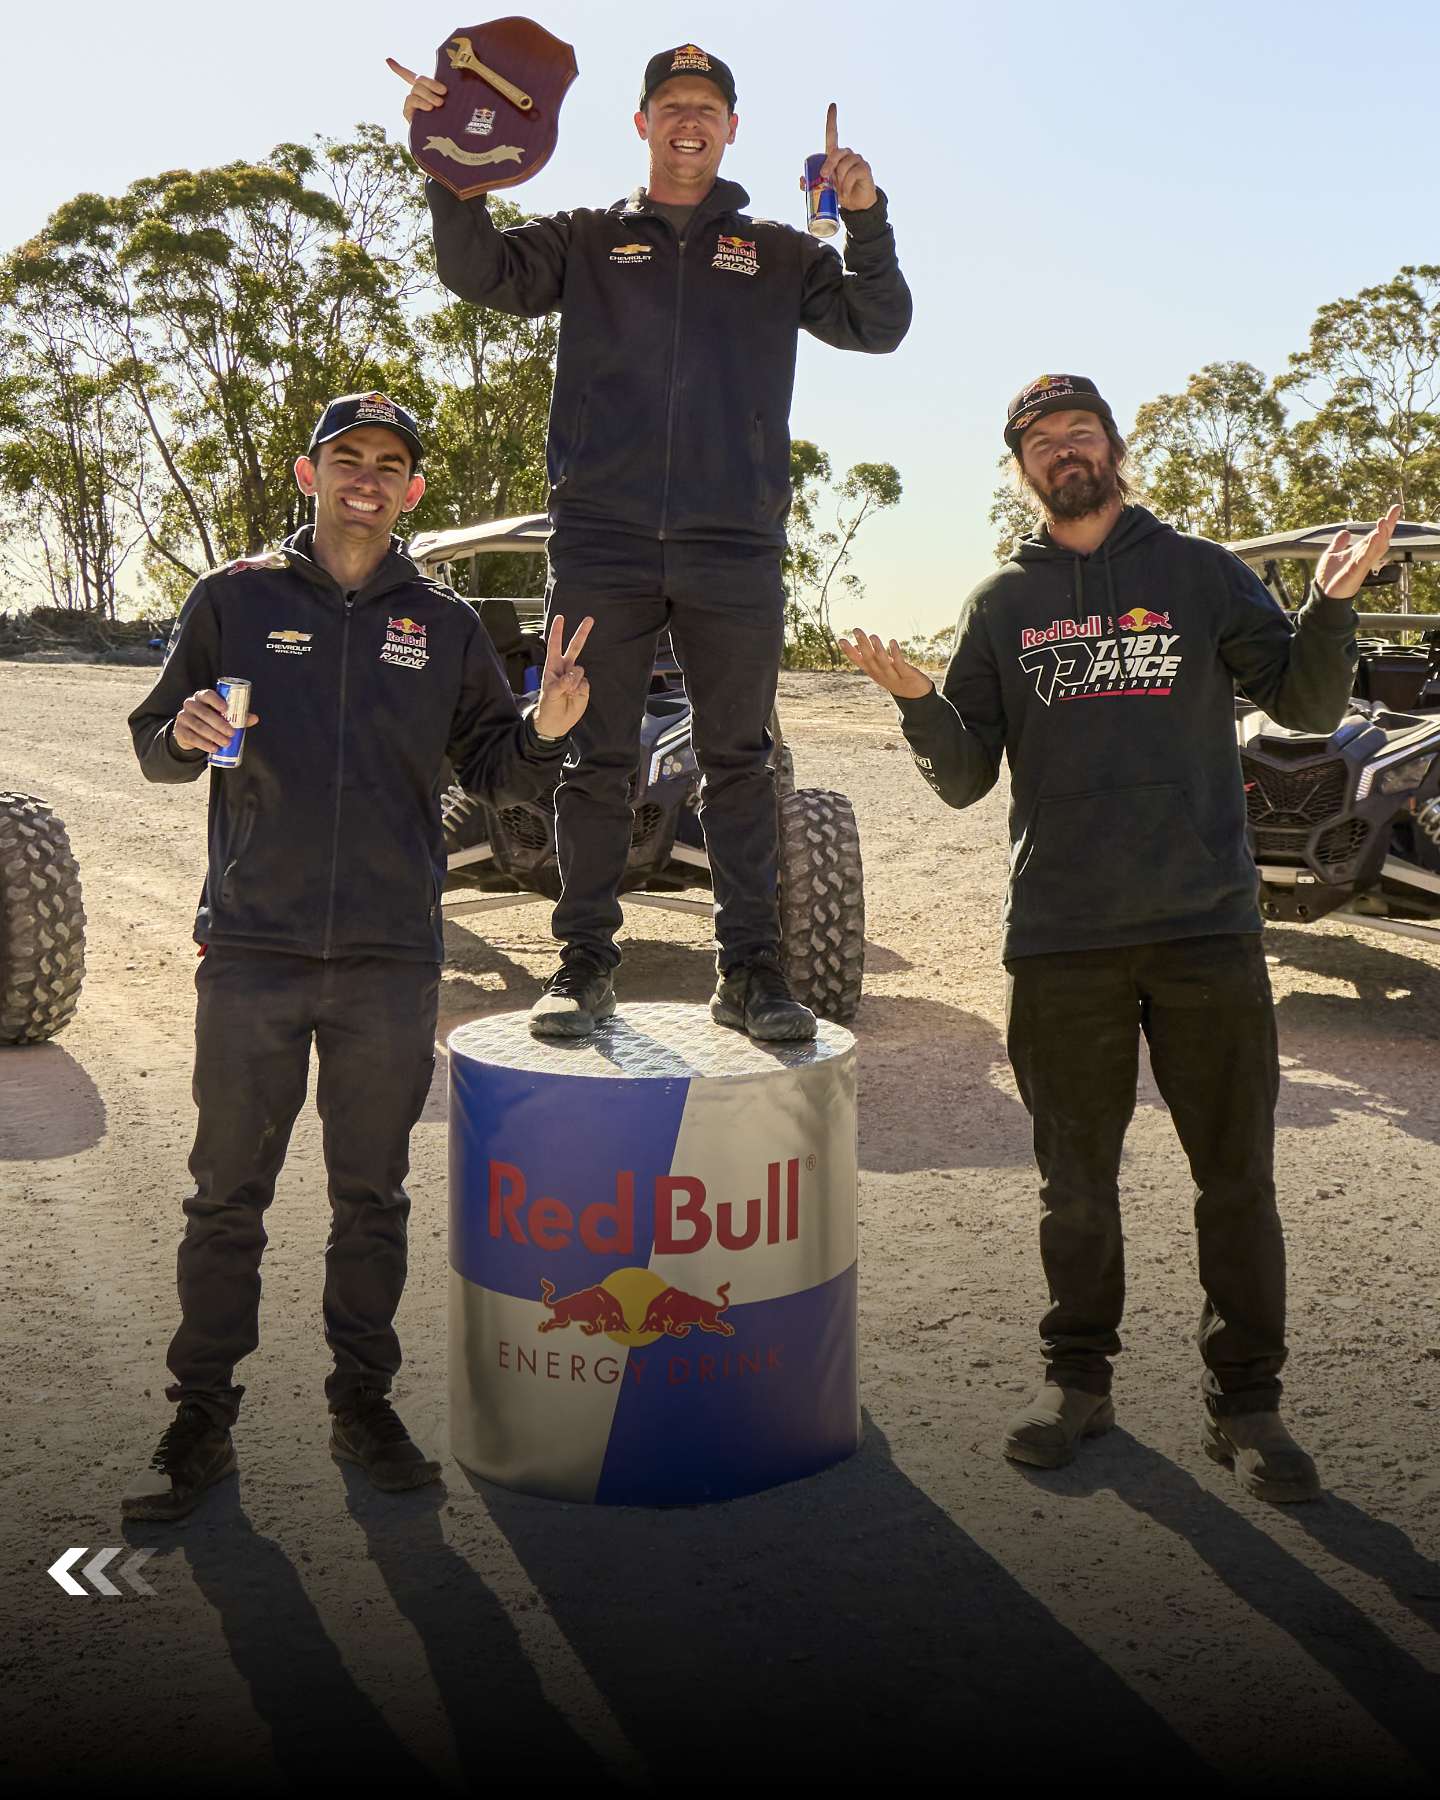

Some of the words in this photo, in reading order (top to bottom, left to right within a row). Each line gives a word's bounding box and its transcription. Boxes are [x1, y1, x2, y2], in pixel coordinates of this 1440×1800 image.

[671, 59, 712, 69] AMPOL
[718, 243, 737, 255] Red
[738, 247, 757, 259] Bull
[711, 260, 758, 274] RACING
[713, 253, 761, 268] AMPOL
[356, 407, 399, 421] AMPOL
[428, 587, 458, 603] AMPOL
[386, 630, 405, 642] Red
[406, 635, 427, 648] Bull
[1022, 620, 1060, 649] Red
[1061, 615, 1102, 640] Bull
[266, 643, 312, 652] CHEVROLET
[381, 642, 430, 660] AMPOL
[379, 652, 427, 667] RACING
[1058, 678, 1174, 698] MOTORSPORT
[488, 1159, 636, 1255] Red
[653, 1157, 800, 1256] Bull
[498, 1340, 646, 1386] ENERGY
[668, 1343, 785, 1386] DRINK
